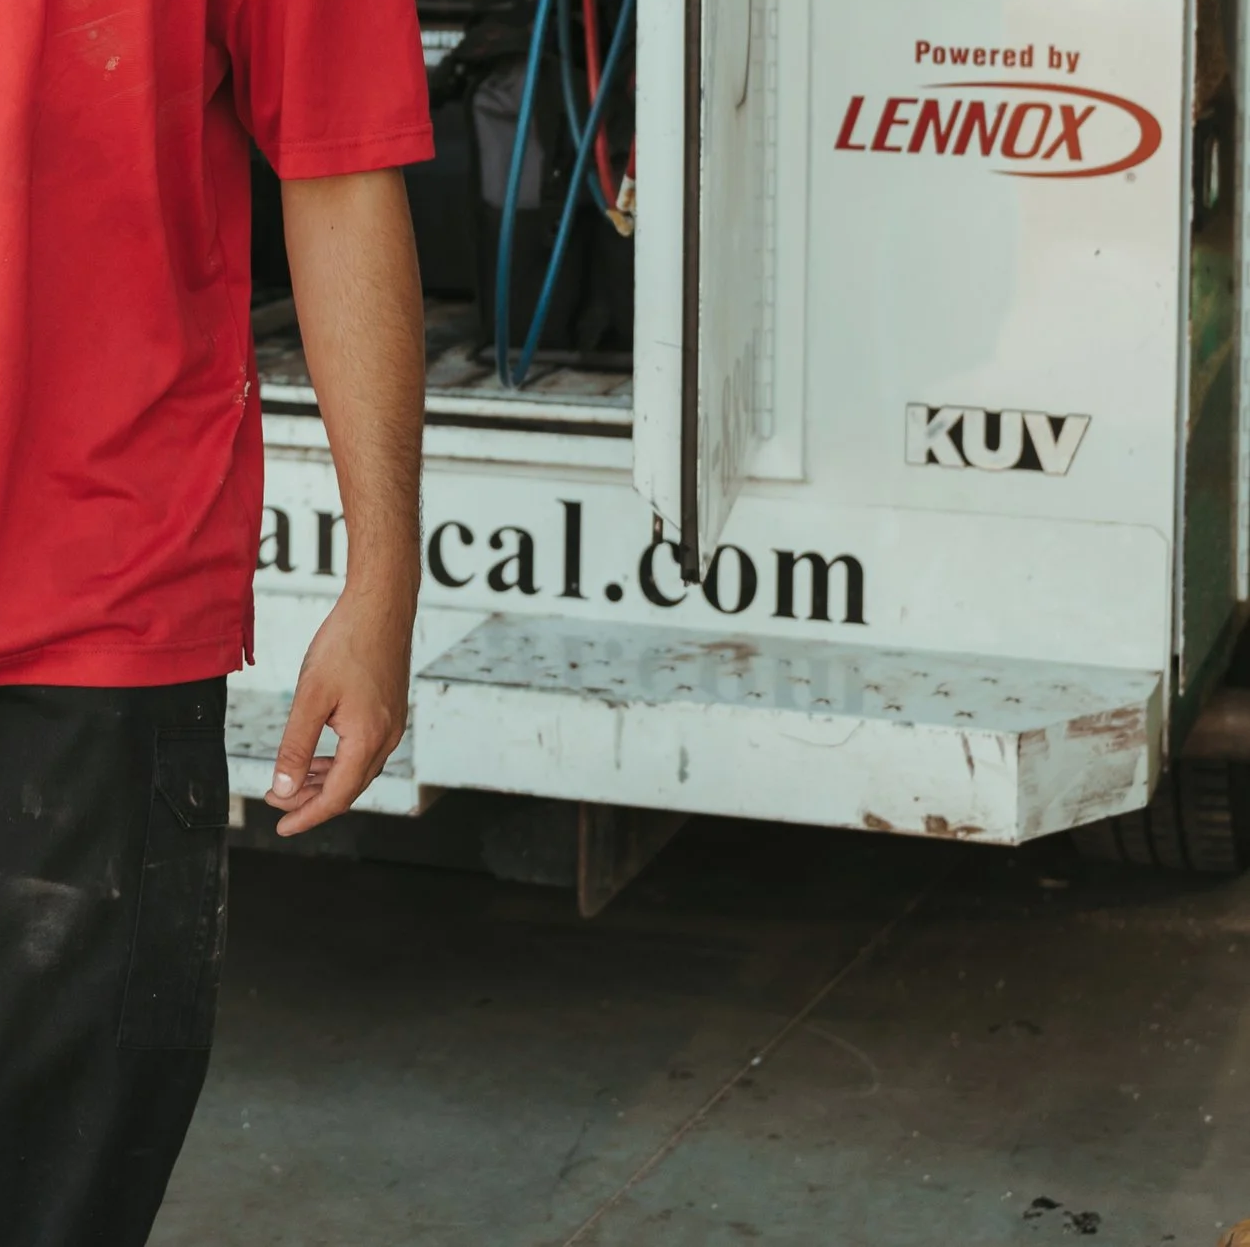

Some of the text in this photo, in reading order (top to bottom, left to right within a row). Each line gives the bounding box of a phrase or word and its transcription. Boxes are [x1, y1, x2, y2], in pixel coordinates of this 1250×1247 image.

[915, 40, 1080, 73] Powered by
[834, 95, 1096, 161] LENNOX
[905, 402, 1092, 477] KUV
